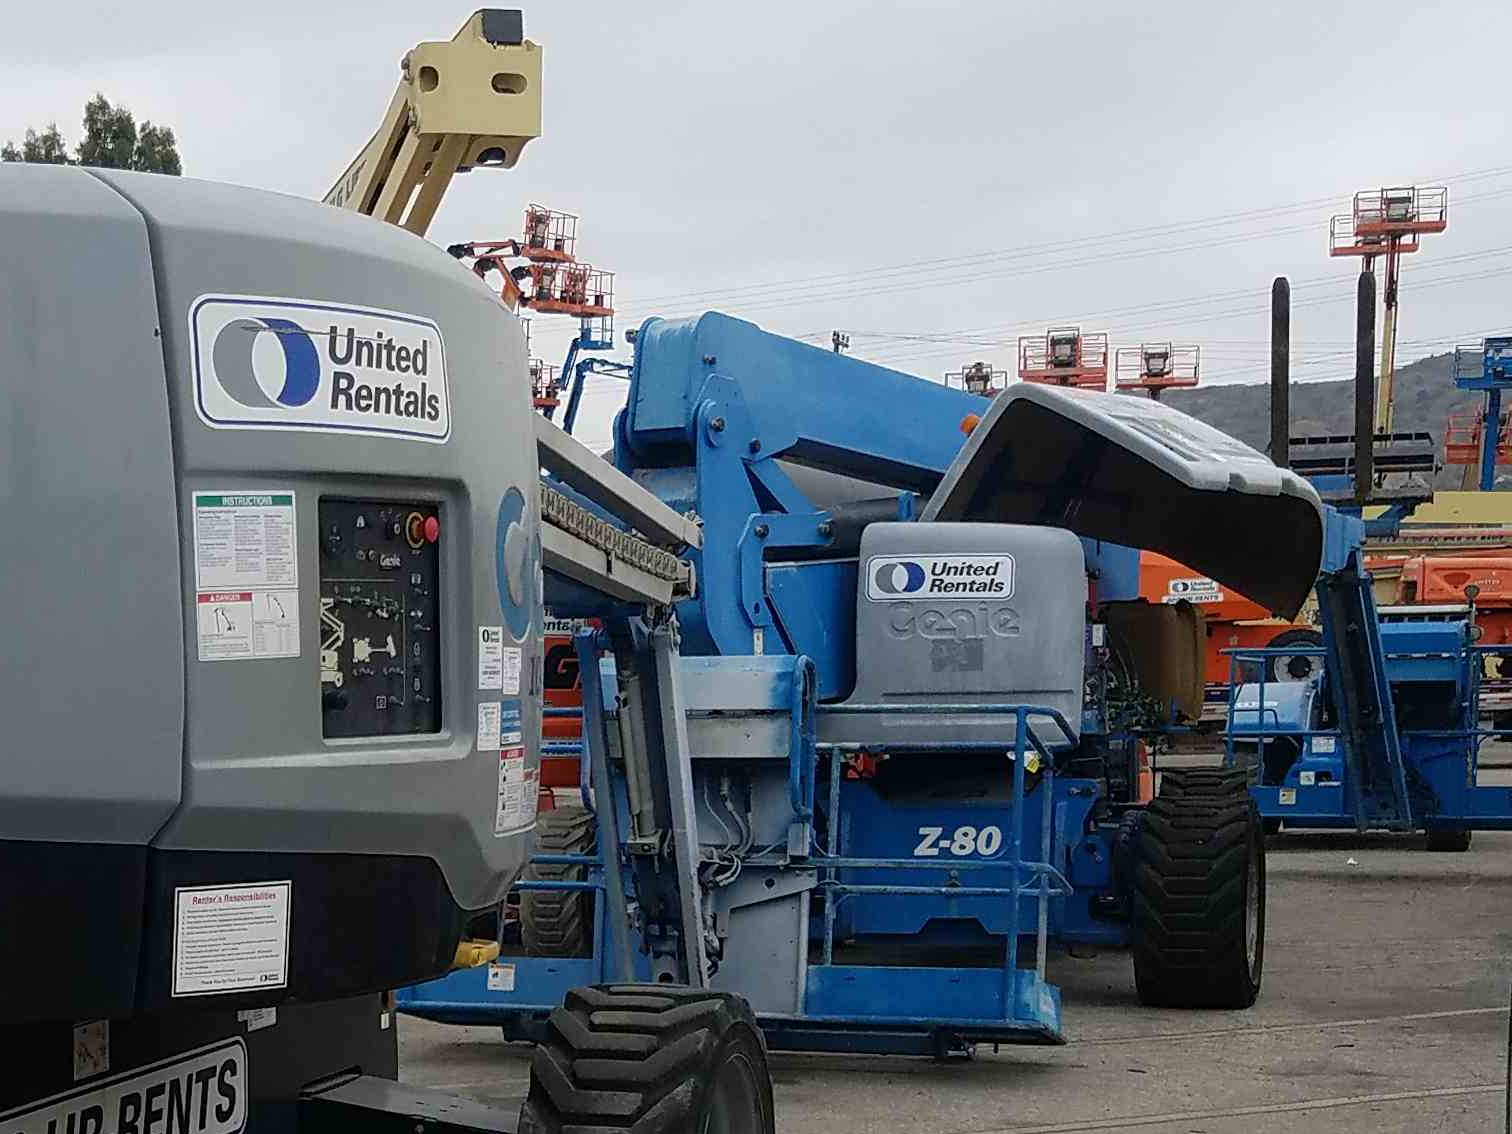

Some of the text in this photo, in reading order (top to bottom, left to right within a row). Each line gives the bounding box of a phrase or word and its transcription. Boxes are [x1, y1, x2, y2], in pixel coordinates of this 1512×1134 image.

[328, 325, 428, 377] United
[330, 371, 440, 422] Rentals
[929, 578, 1005, 593] Rentals
[931, 561, 1000, 577] United
[887, 601, 1022, 640] Genie
[914, 825, 1002, 856] Z-80
